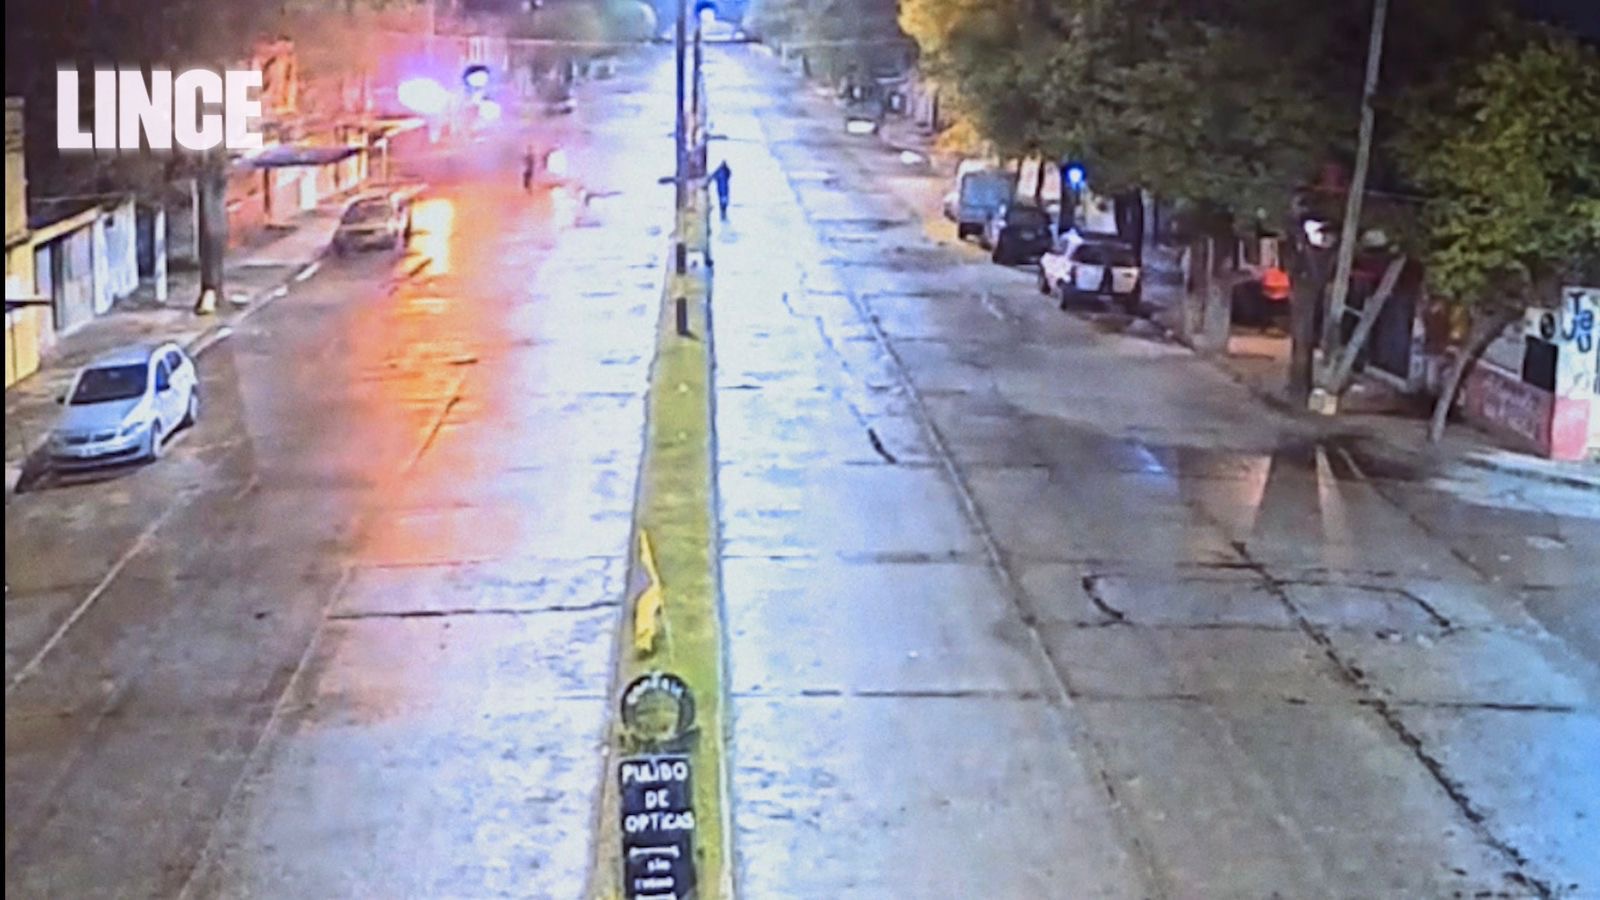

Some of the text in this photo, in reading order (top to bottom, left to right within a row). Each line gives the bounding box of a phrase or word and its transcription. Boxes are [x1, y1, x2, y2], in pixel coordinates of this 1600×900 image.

[622, 763, 688, 785] PULIDO
[645, 789, 669, 809] DE
[625, 811, 695, 833] OPTICAS
